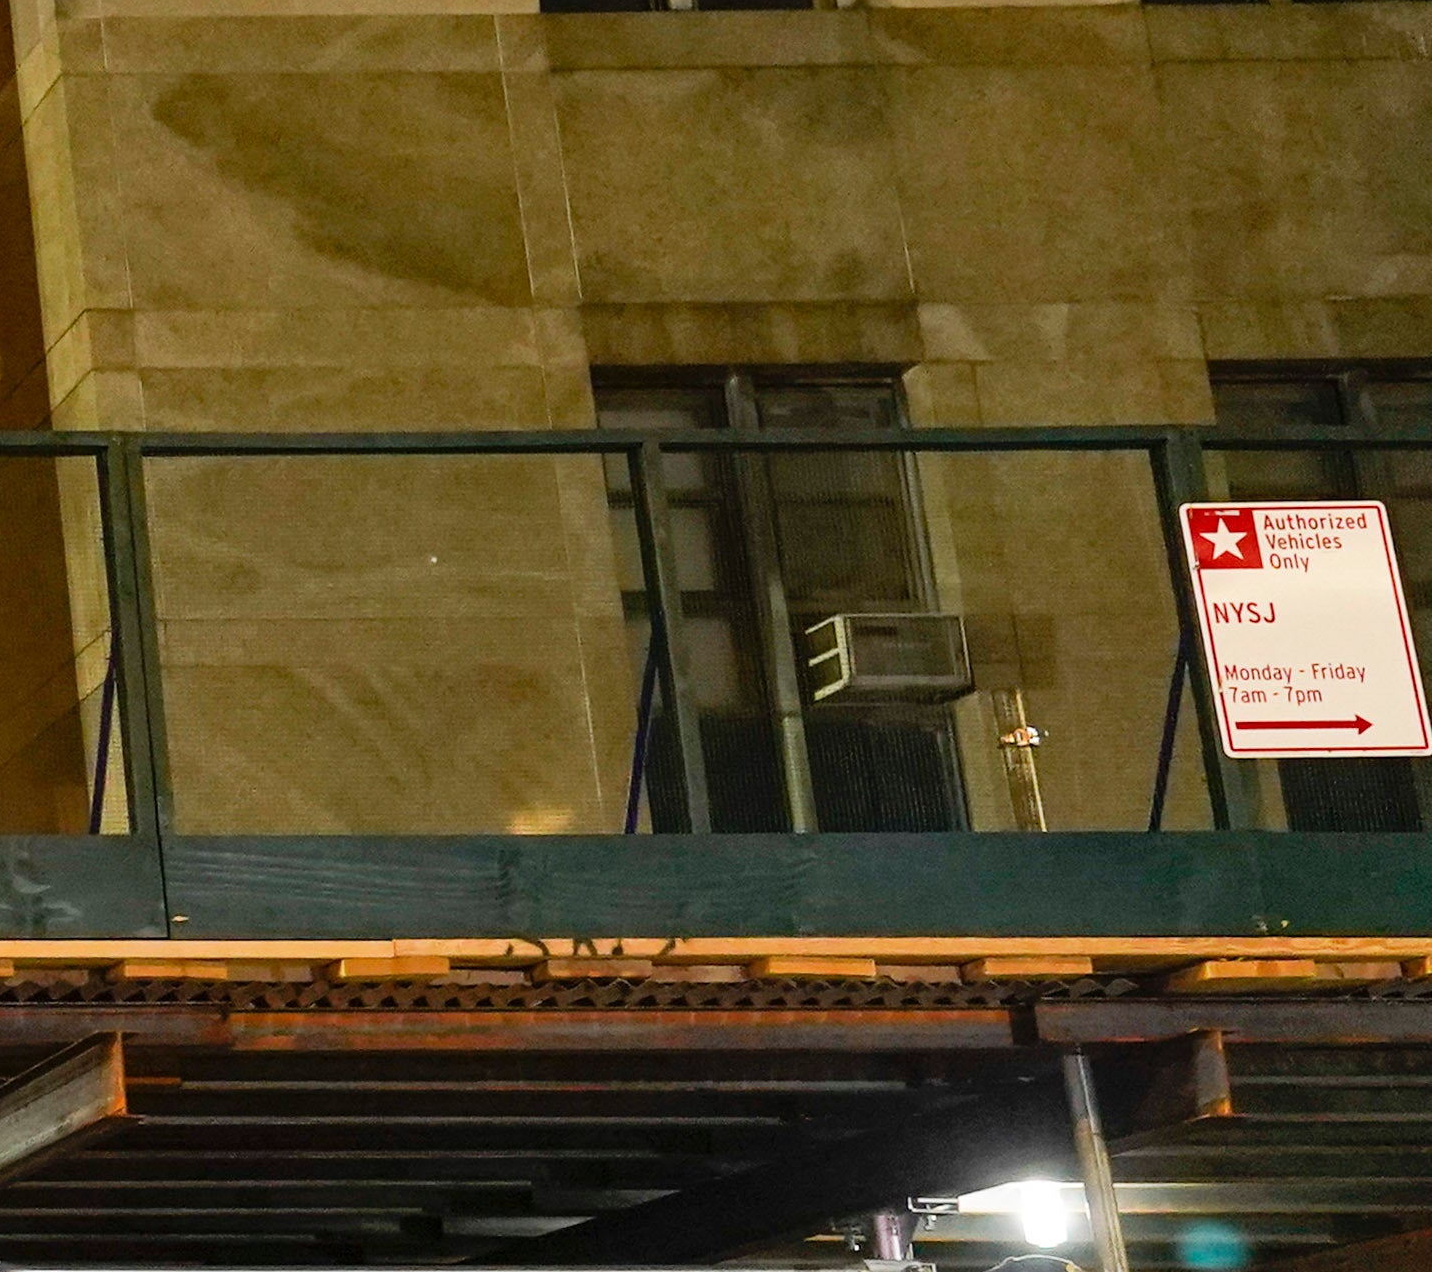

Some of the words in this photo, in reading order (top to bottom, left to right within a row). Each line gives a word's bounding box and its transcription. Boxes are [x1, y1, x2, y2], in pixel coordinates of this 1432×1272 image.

[1263, 513, 1368, 531] Authorized
[1265, 534, 1343, 550] Vehicles
[1269, 553, 1310, 573] Only
[1213, 602, 1277, 624] NYSJ
[1224, 663, 1293, 684] Monday
[1311, 662, 1366, 684] Friday
[1228, 687, 1267, 704] 7am
[1284, 686, 1323, 706] 7pm
